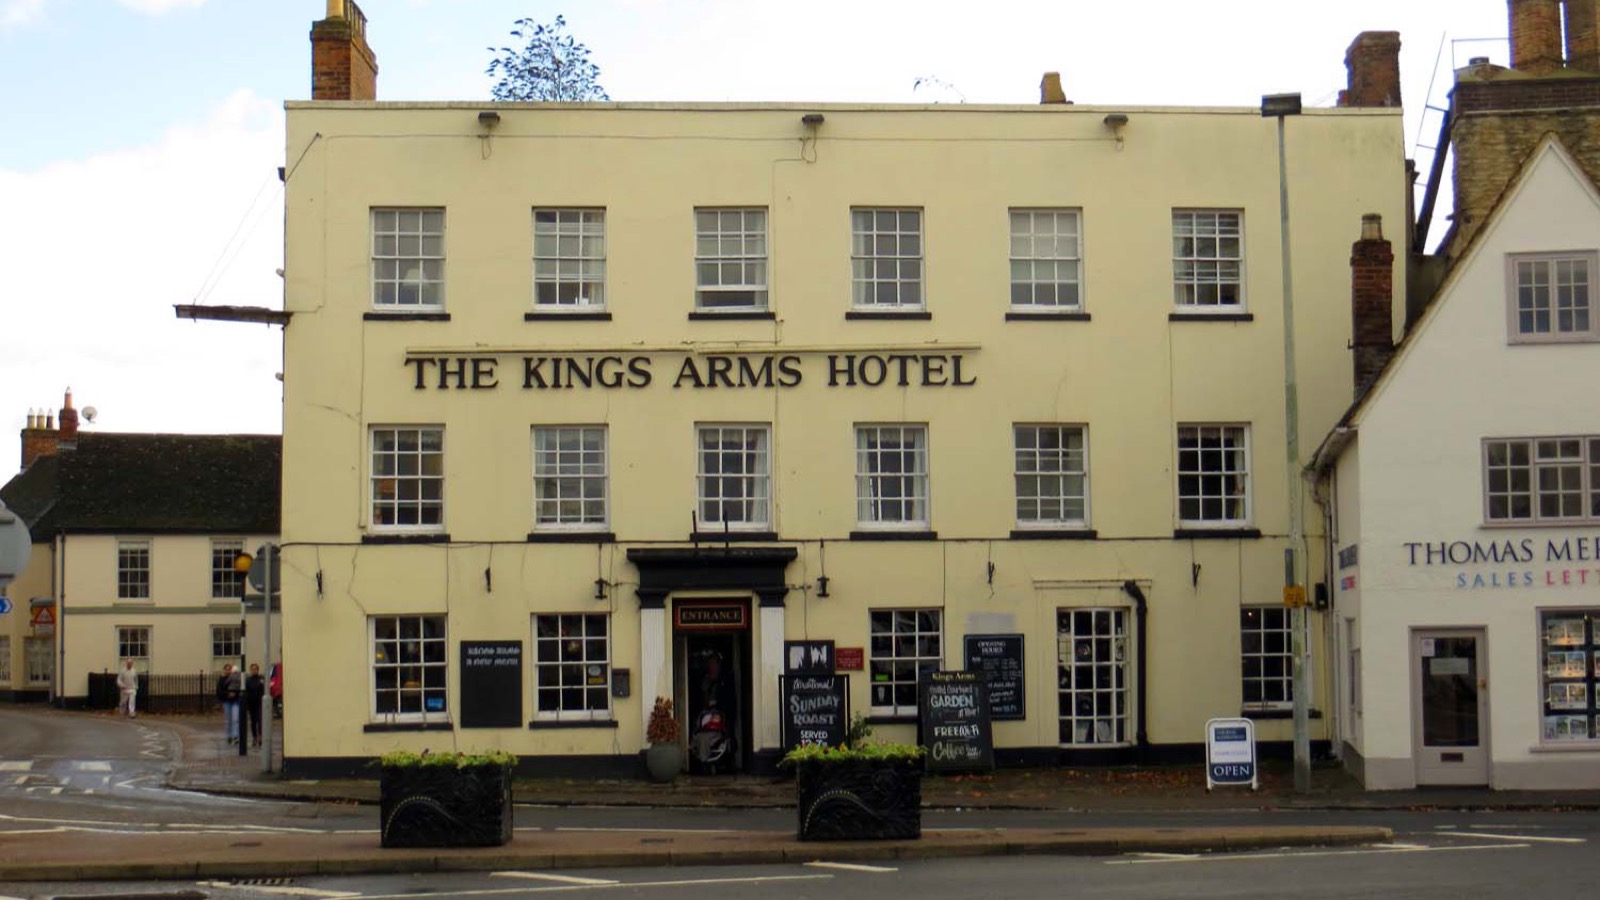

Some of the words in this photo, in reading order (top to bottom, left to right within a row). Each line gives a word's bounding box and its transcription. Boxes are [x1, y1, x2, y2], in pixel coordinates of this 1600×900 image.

[404, 356, 499, 390] THE
[522, 356, 652, 389] KINGS
[673, 355, 803, 389] ARMS
[827, 354, 977, 388] HOTEL
[1404, 539, 1533, 565] THOMAS
[1457, 571, 1533, 588] SALES
[681, 609, 740, 621] ENTRANCE
[932, 672, 954, 681] Kings
[956, 672, 975, 680] Arms
[790, 694, 838, 713] SUNDAY
[931, 695, 974, 708] GARDEN
[793, 714, 835, 725] ROAST
[800, 730, 828, 739] SERVED
[934, 726, 959, 737] FREE
[932, 741, 965, 761] Coffee
[1213, 765, 1250, 776] OPEN
